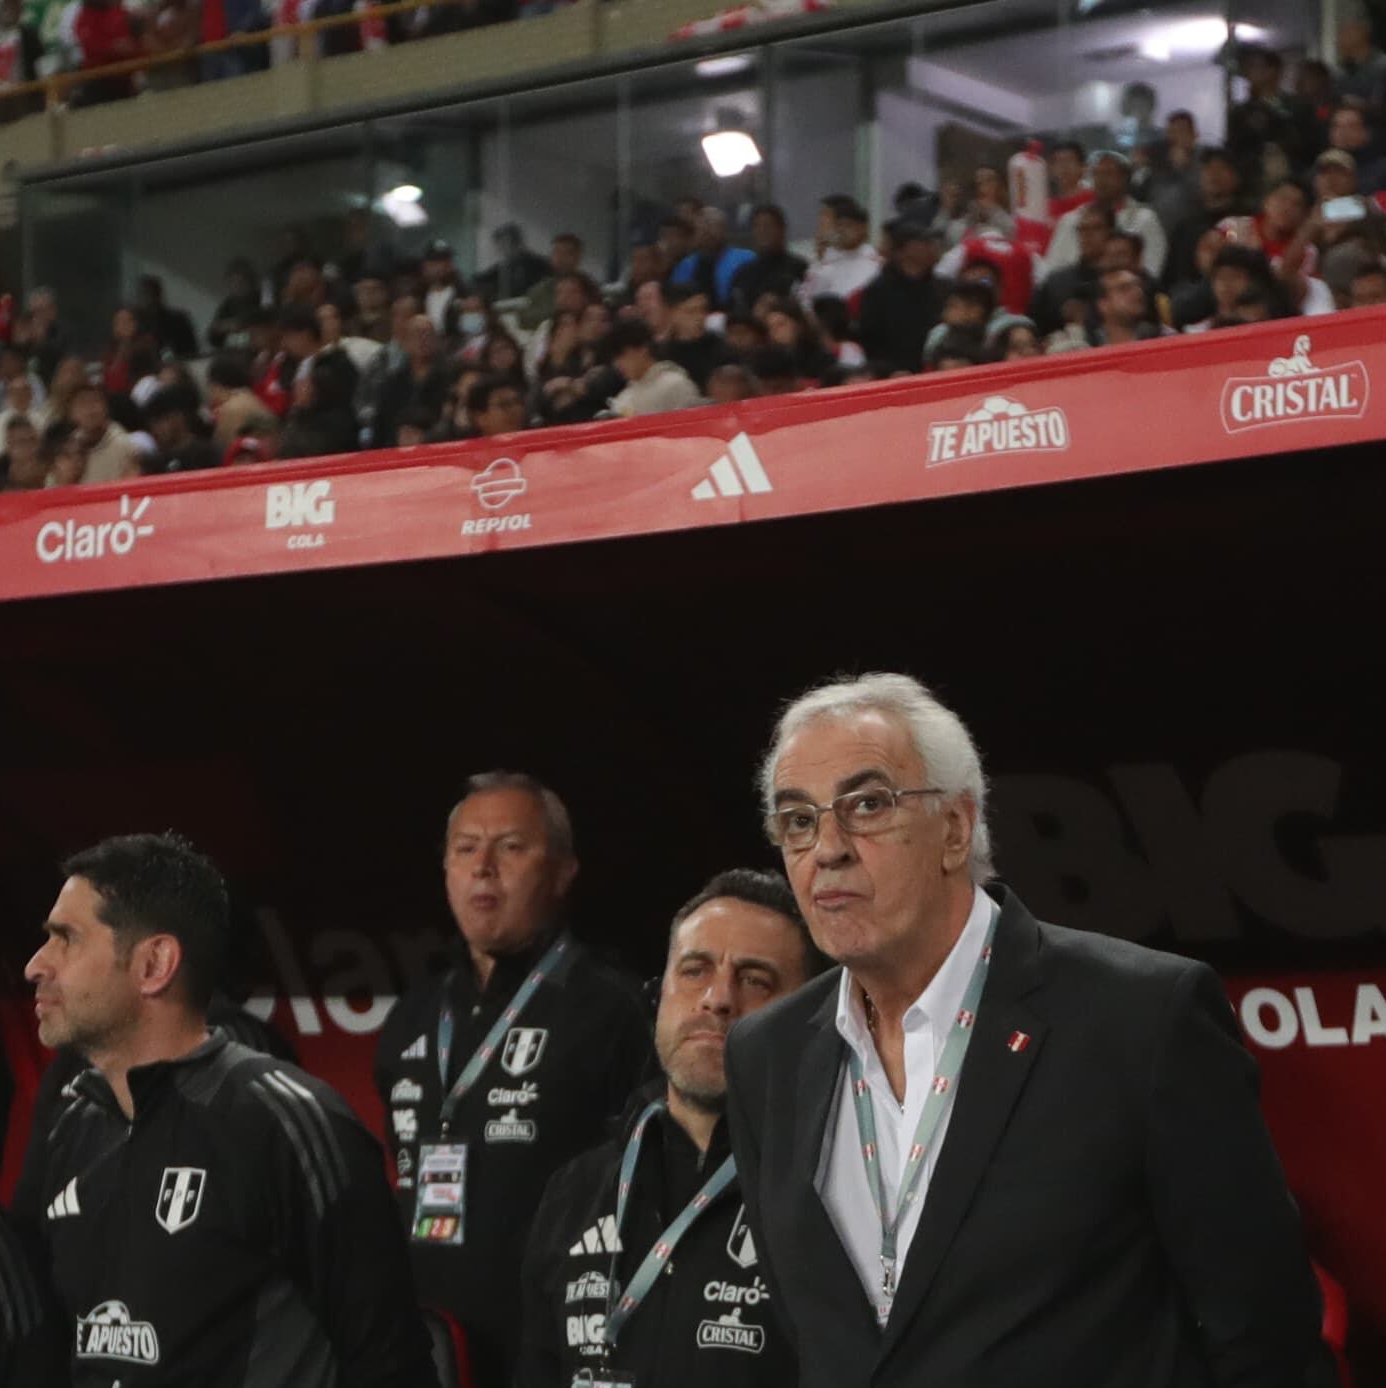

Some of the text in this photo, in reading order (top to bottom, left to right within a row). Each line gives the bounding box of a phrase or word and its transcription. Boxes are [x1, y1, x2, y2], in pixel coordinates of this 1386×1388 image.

[1231, 374, 1358, 422] CRISTAL
[930, 411, 1067, 462] TE APUESTO
[265, 481, 335, 529] BIG
[36, 519, 135, 564] Claro
[287, 533, 326, 550] COLA
[461, 513, 532, 536] REPSOL
[704, 1280, 761, 1305] Claro
[86, 1324, 156, 1360] APUESTO
[566, 1313, 607, 1347] BIG
[702, 1325, 758, 1347] CRISTAL
